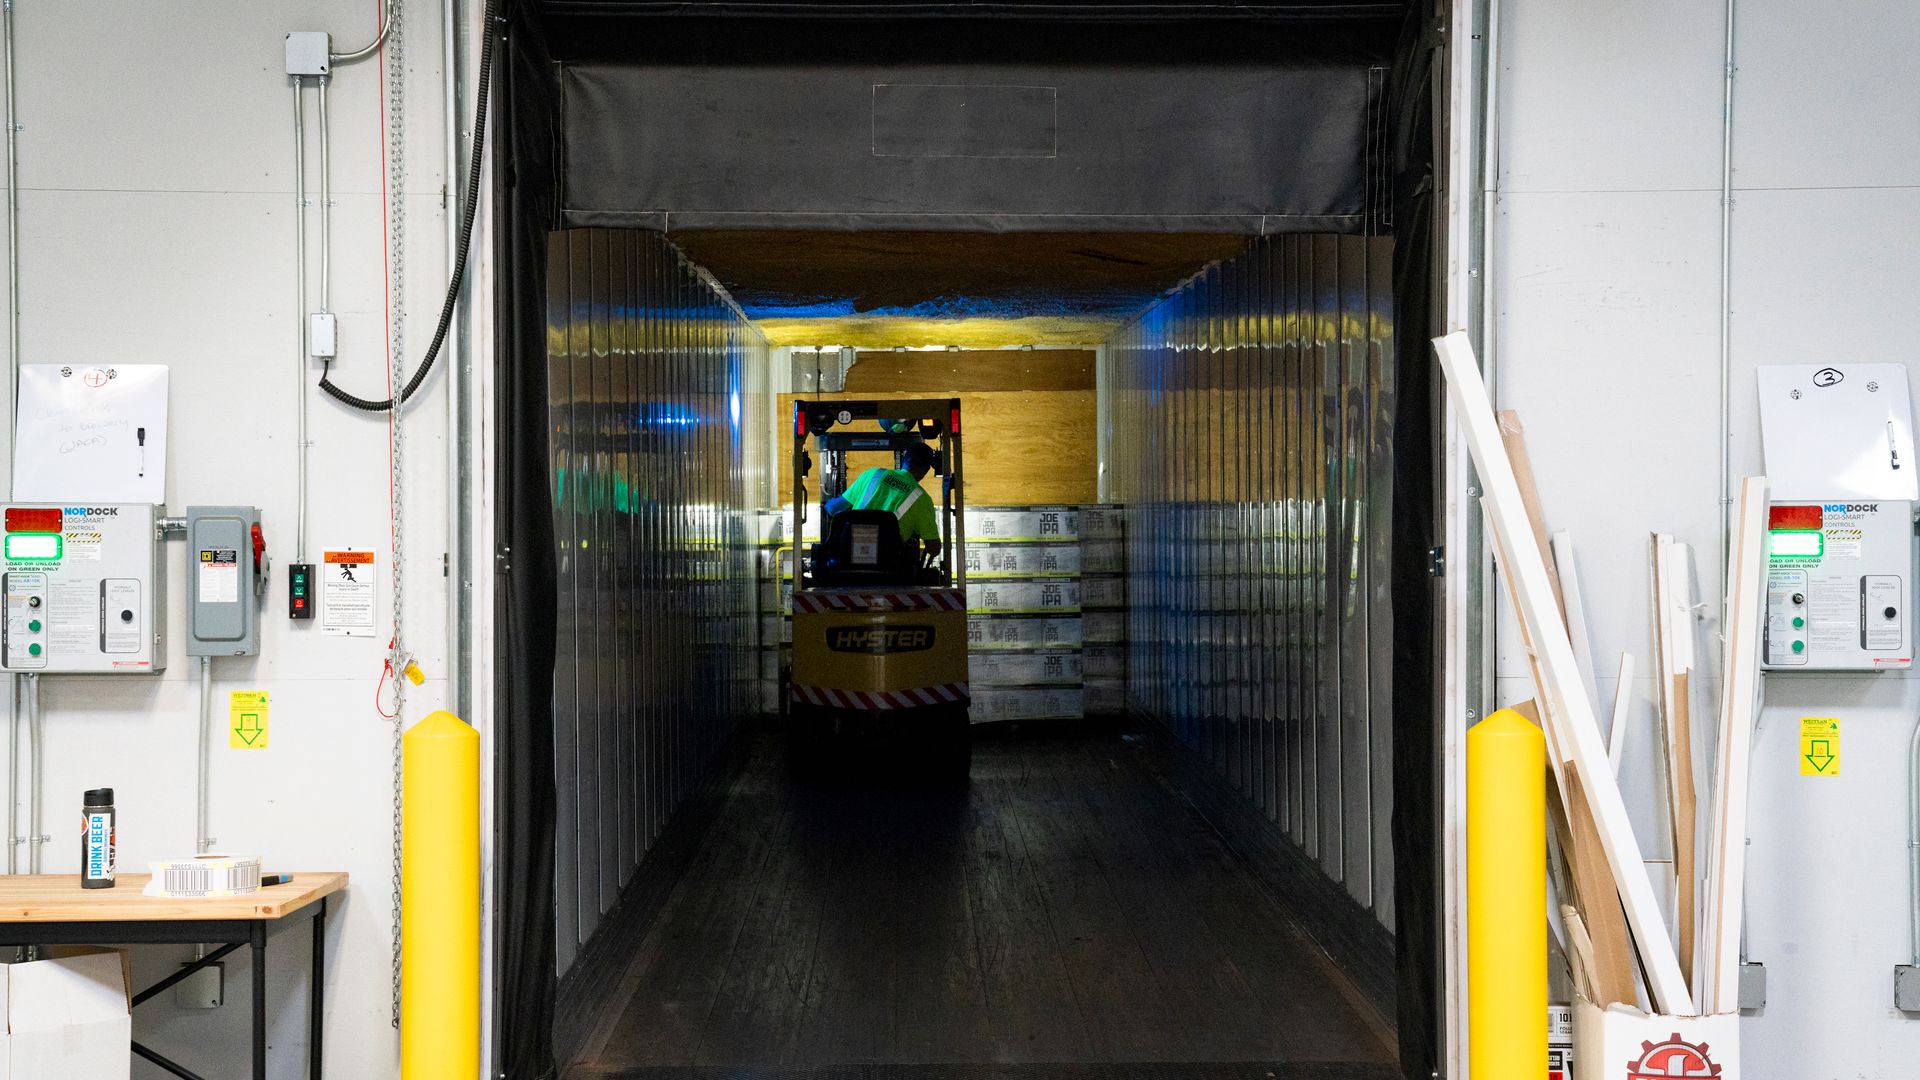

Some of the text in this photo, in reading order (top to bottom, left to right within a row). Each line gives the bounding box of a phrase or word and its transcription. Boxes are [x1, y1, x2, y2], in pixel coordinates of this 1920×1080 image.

[64, 507, 118, 517] NORDOCK
[1823, 504, 1878, 514] NORDOCK
[1040, 513, 1059, 522] JOE
[983, 520, 996, 528] JOE
[1040, 523, 1059, 535] IPA
[982, 527, 996, 536] IPA
[1003, 562, 1017, 571] IPA
[1043, 562, 1057, 571] IPA
[1042, 584, 1061, 594] JOE
[985, 591, 998, 599] JOE
[1042, 594, 1061, 606] IPA
[984, 598, 998, 607] IPA
[967, 621, 982, 630] OE
[836, 630, 928, 649] HYSTER
[967, 630, 982, 642] PA
[1044, 656, 1063, 666] JOE
[1044, 666, 1063, 677] IPA
[91, 816, 103, 877] DRINK BEER
